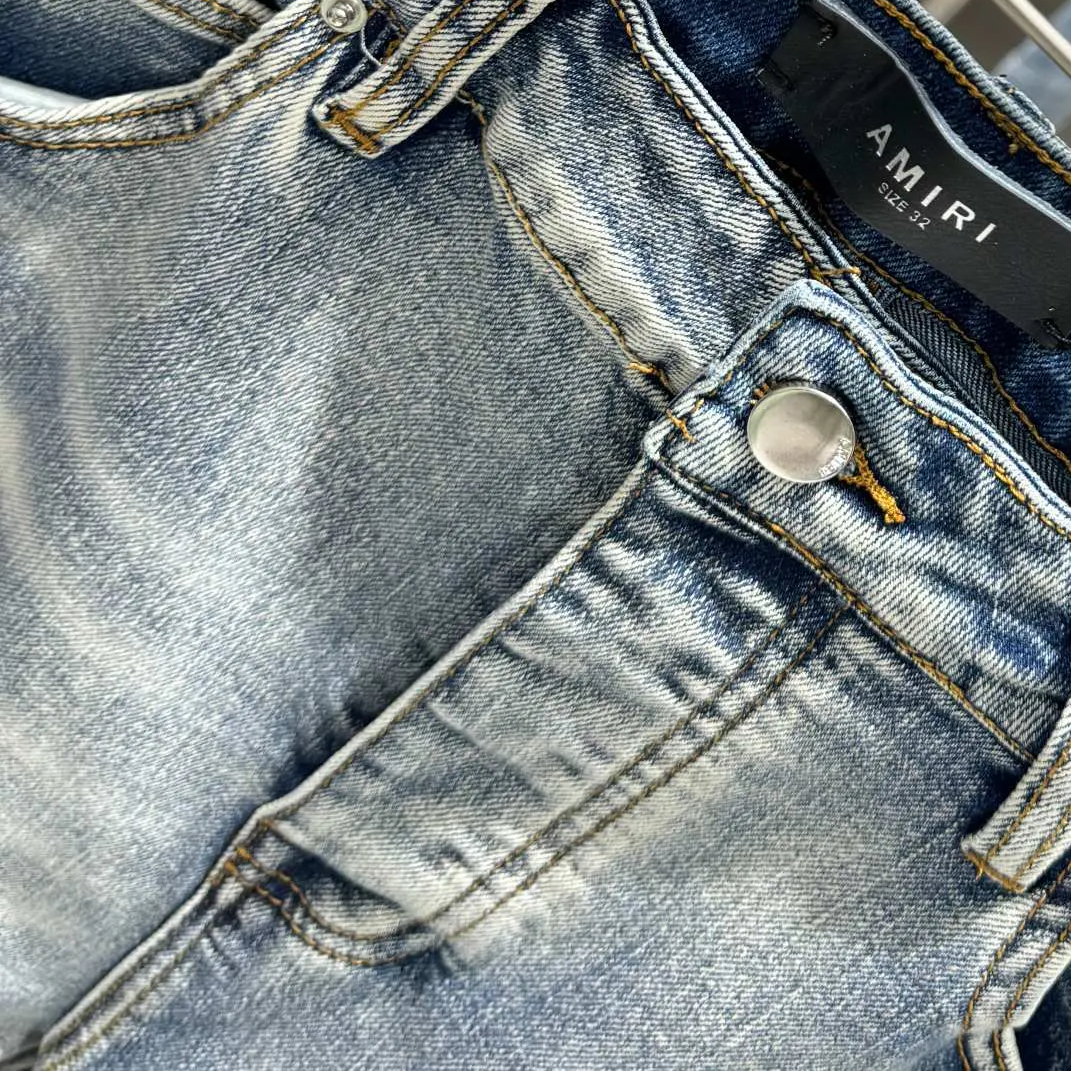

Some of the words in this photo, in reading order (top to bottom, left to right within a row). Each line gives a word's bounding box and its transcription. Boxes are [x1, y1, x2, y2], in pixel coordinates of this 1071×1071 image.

[866, 123, 997, 243] AMIRI
[878, 182, 909, 213] SIZE
[909, 210, 931, 231] 32
